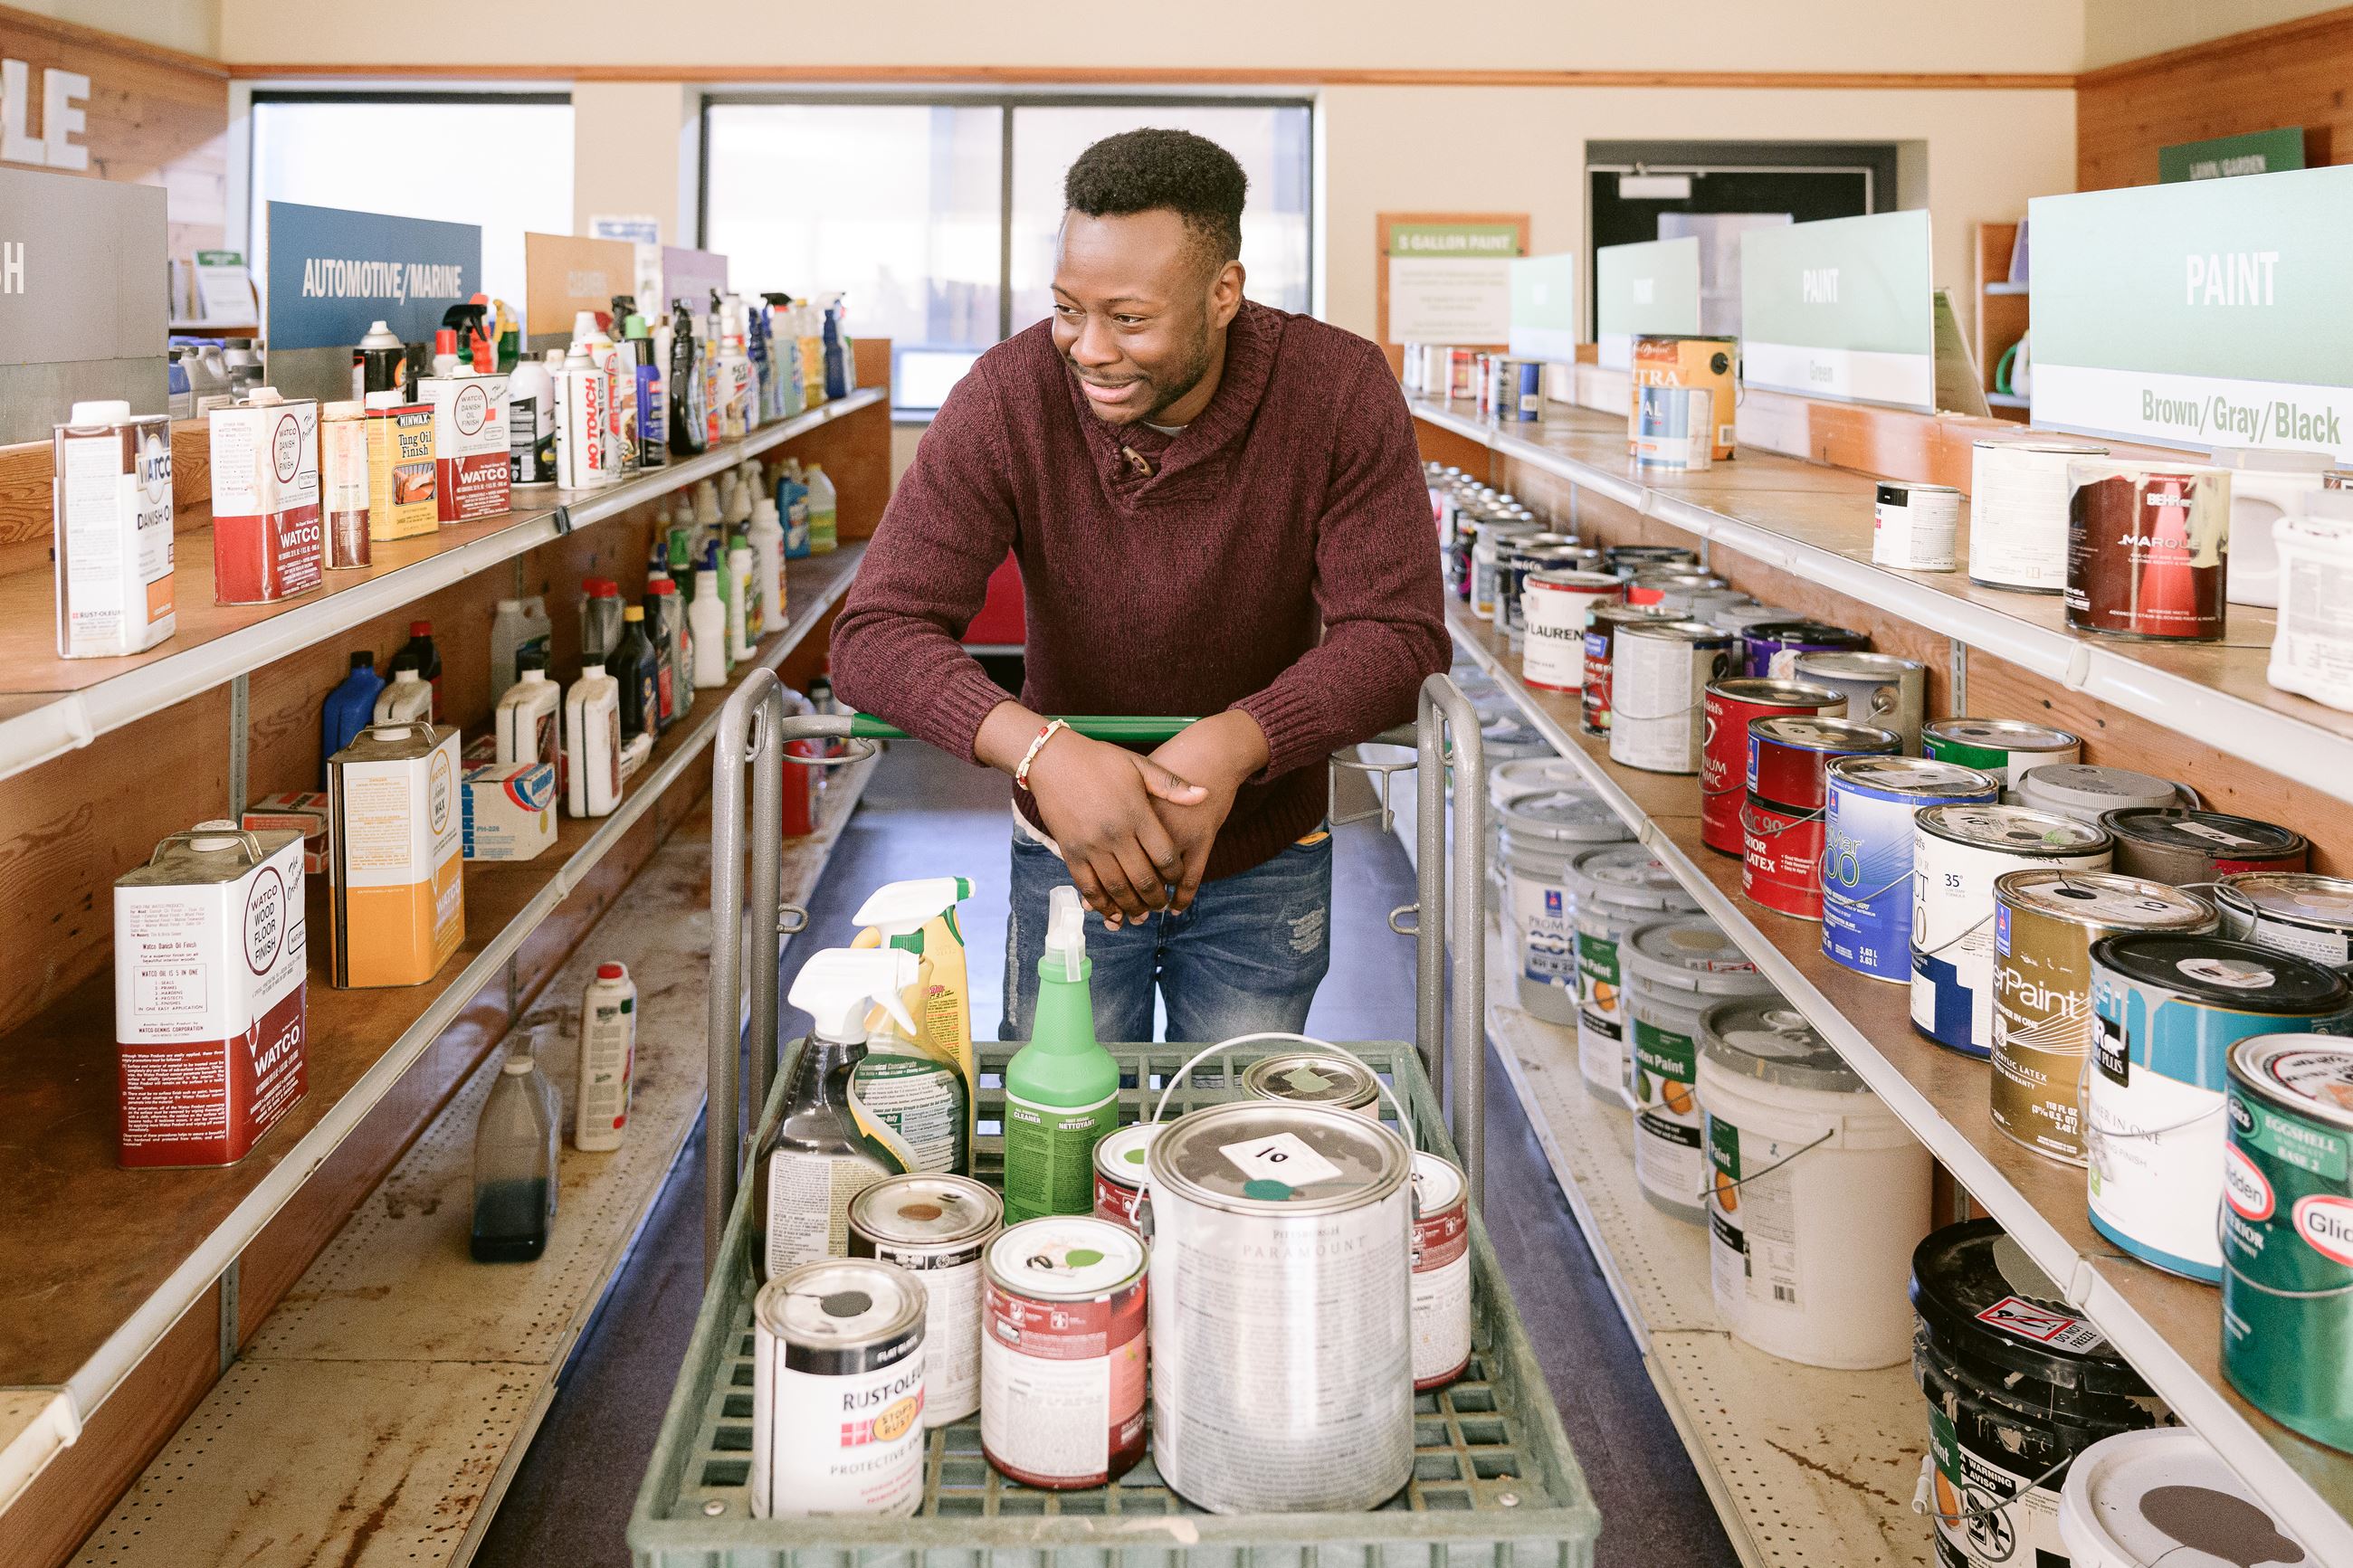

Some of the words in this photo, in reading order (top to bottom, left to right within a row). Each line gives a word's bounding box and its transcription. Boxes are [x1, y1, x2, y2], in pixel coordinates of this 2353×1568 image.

[0, 58, 90, 170] LE
[0, 242, 24, 294] H
[2186, 251, 2280, 306] PAINT
[301, 258, 463, 307] AUTOMOTIVE/MARINE
[1803, 268, 1840, 304] PAINT
[1809, 359, 1834, 384] Green
[461, 394, 482, 403] WATCO
[461, 404, 481, 413] DANISH
[584, 376, 598, 441] TOUCH
[399, 413, 429, 428] MINWAX
[462, 419, 480, 427] FINISH
[2141, 389, 2342, 445] Brown/Gray/Black
[279, 427, 298, 438] WATCO
[398, 434, 418, 447] Tung
[419, 432, 433, 444] Oil
[279, 441, 296, 451] DANISH
[282, 451, 291, 461] OIL
[402, 444, 430, 459] Finish
[587, 442, 601, 470] NO
[279, 461, 295, 471] FINISH
[461, 467, 508, 485] WATCO
[2146, 492, 2179, 507] BEHR
[137, 509, 164, 531] DANISH
[280, 525, 319, 549] WATCO
[1529, 625, 1585, 642] LAUREN
[434, 797, 445, 817] WAX
[1762, 816, 1784, 839] 99
[1747, 849, 1776, 874] LATEX
[1945, 873, 1964, 888] 35°
[251, 884, 278, 912] WATCO
[253, 902, 275, 927] WOOD
[253, 918, 277, 946] FLOOR
[254, 936, 277, 965] FINISH
[188, 968, 198, 976] ONE
[2021, 1017, 2039, 1030] ONE
[254, 1024, 300, 1078] WATCO
[1653, 1052, 1685, 1077] Paint
[2019, 1064, 2047, 1082] LATEX
[2101, 1050, 2124, 1075] PLUS
[2005, 1069, 2035, 1090] WARRANTY
[1013, 1110, 1042, 1125] CLEANER
[2058, 1104, 2067, 1114] FL
[2068, 1107, 2078, 1117] OZ
[1057, 1118, 1096, 1130] NETTOYANT
[2113, 1114, 2126, 1131] IN
[2129, 1124, 2161, 1146] ONE
[2264, 1114, 2338, 1155] EGGSHELL
[2310, 1158, 2321, 1172] 2
[1243, 1234, 1368, 1259] PARAMOUNT
[2053, 1333, 2071, 1344] DO
[2064, 1324, 2084, 1336] NOT
[2069, 1330, 2097, 1349] FREEZE
[876, 1346, 897, 1363] FLAT
[882, 1402, 914, 1426] STOPS
[883, 1413, 912, 1436] RUST
[830, 1447, 906, 1476] PROTECTIVE
[1968, 1458, 2014, 1489] WARNING
[1968, 1471, 1997, 1492] AVISO
